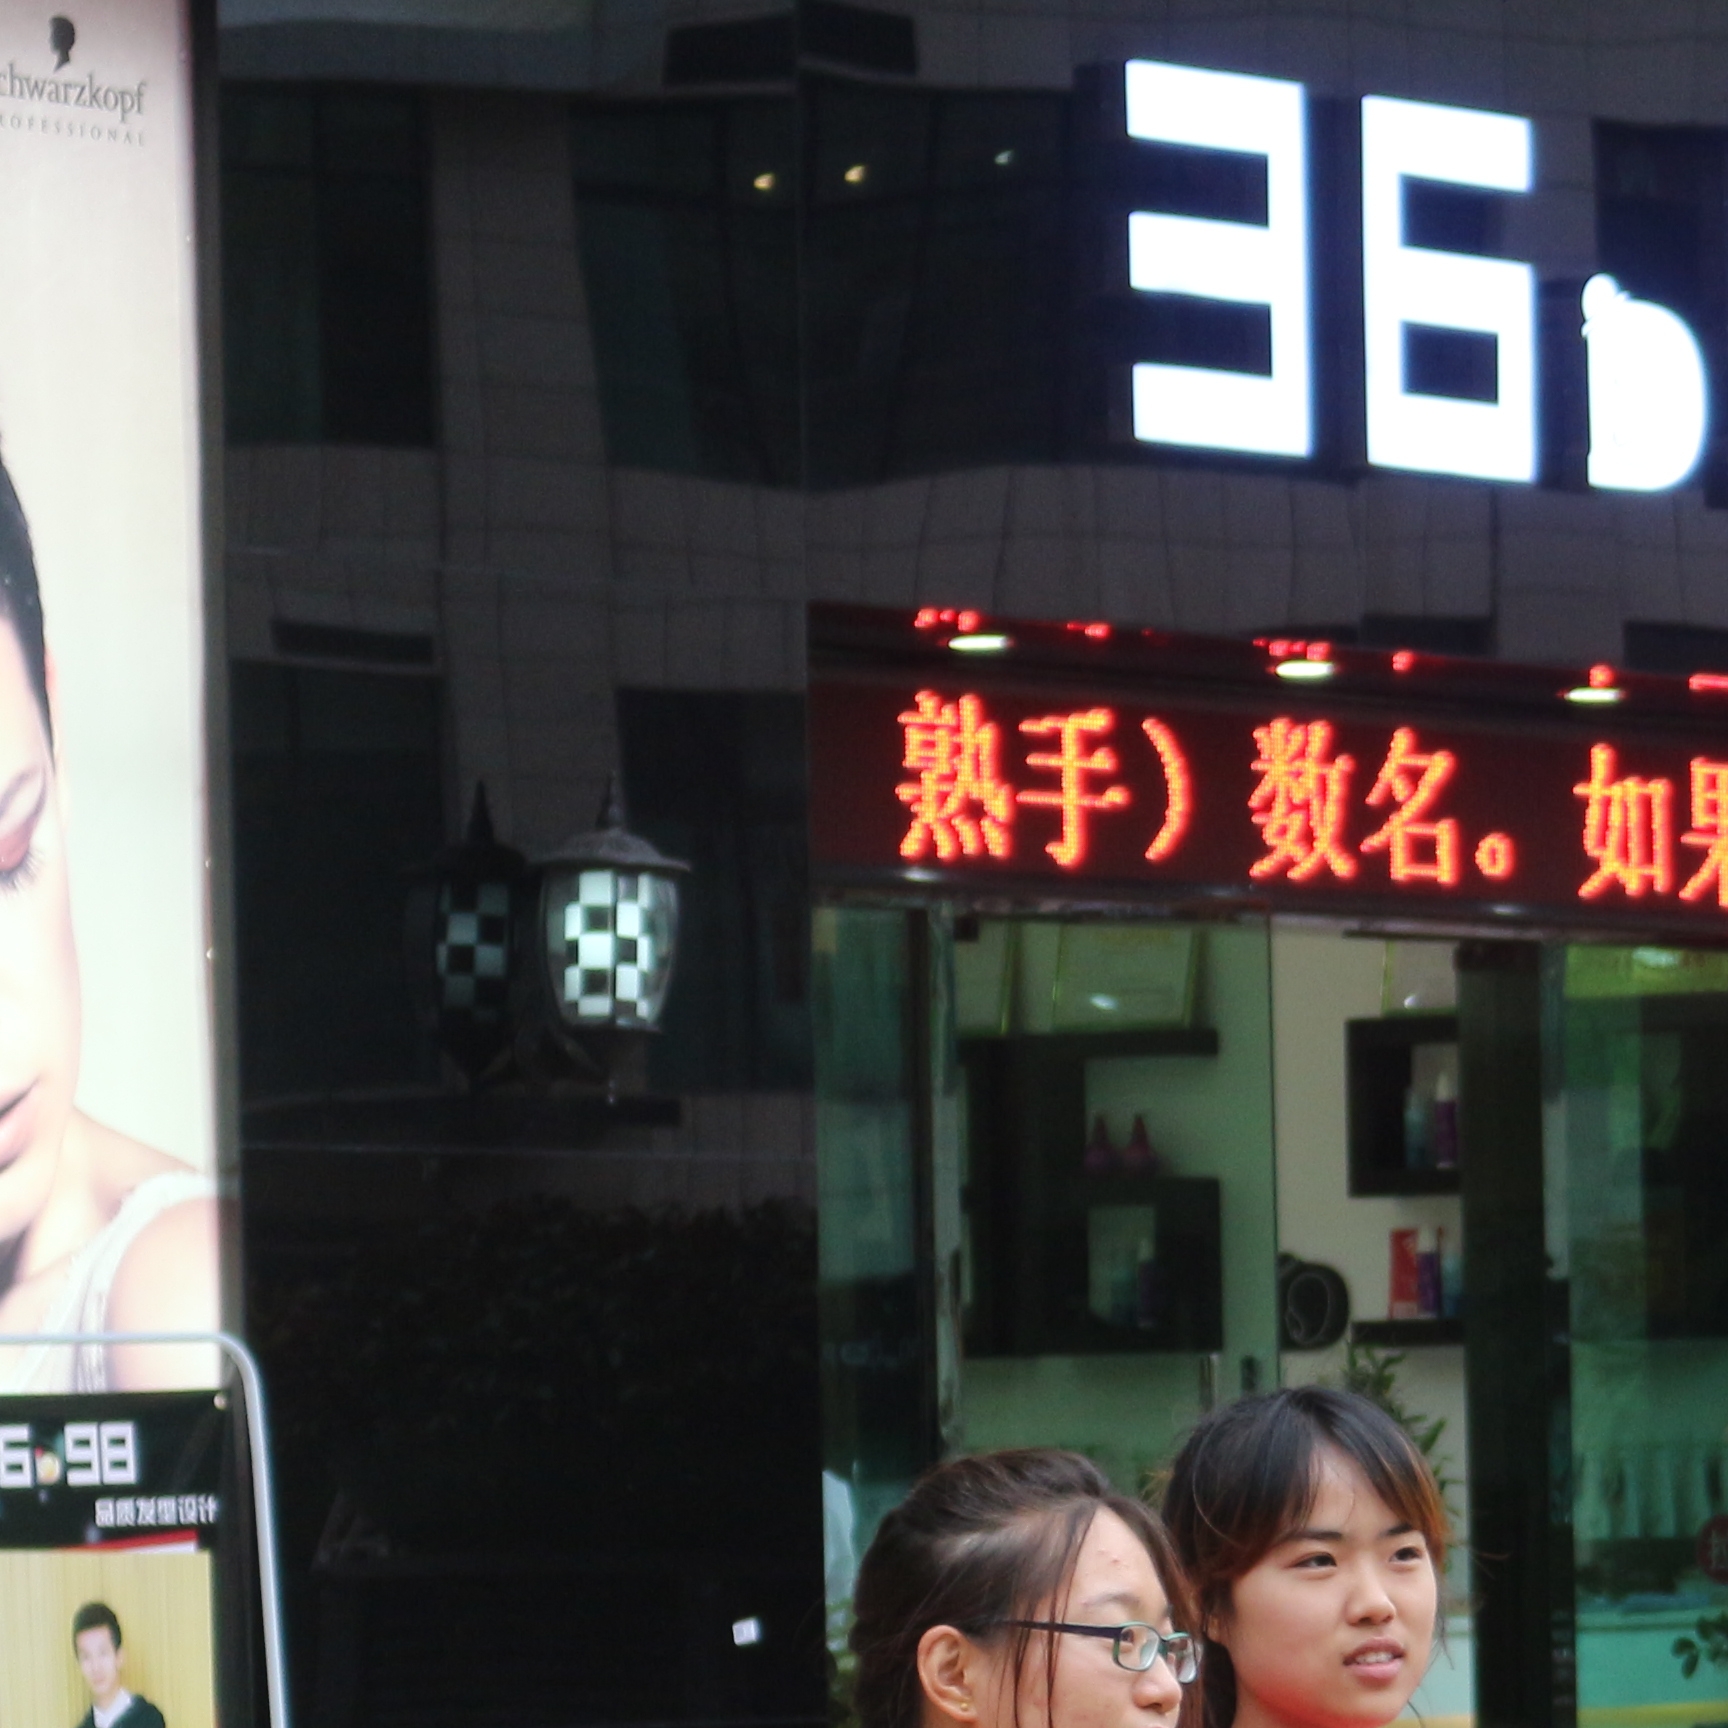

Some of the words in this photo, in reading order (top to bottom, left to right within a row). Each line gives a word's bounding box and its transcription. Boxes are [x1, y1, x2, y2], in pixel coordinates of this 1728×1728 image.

[0, 113, 145, 147] OFESSIONAL
[95, 1494, 217, 1528] 品质发型设计
